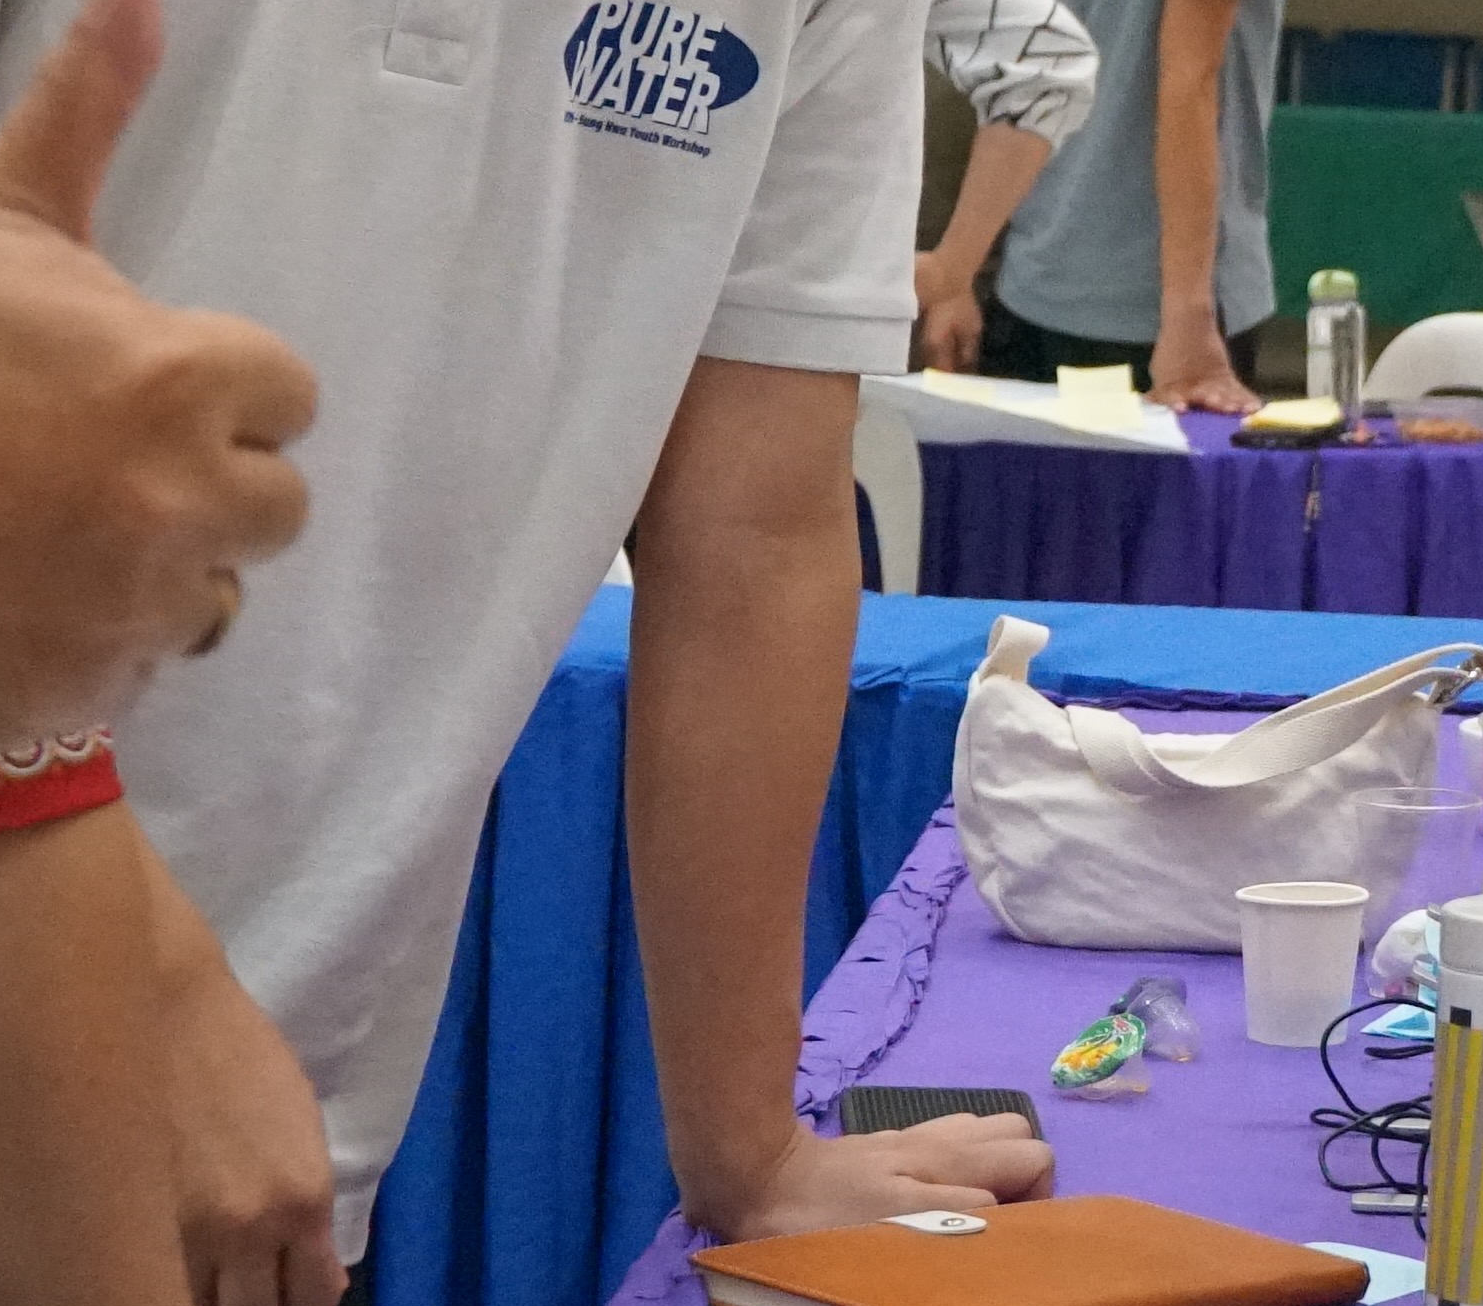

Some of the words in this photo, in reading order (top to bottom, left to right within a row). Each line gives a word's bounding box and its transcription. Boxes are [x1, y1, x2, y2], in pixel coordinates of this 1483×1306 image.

[569, 40, 721, 135] WATER
[629, 127, 660, 144] Youth
[662, 133, 711, 158] Workshop
